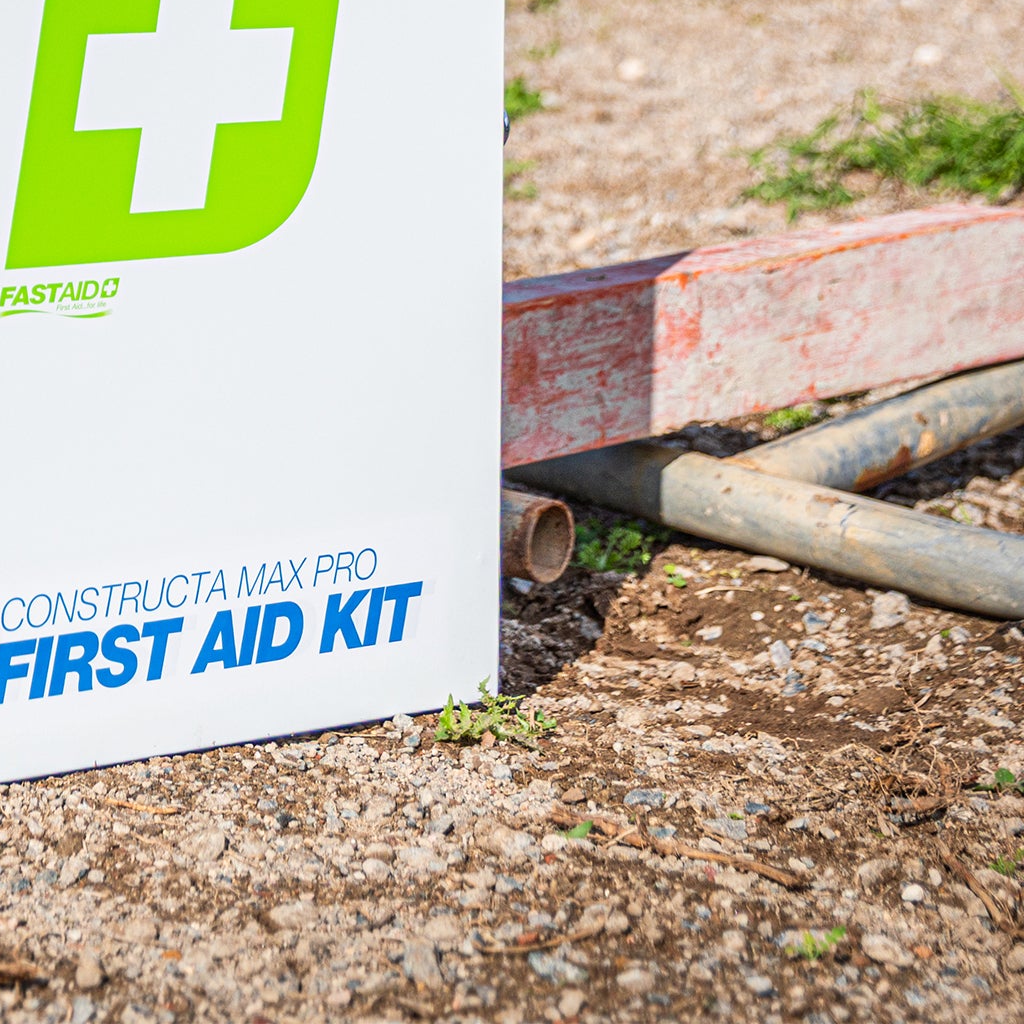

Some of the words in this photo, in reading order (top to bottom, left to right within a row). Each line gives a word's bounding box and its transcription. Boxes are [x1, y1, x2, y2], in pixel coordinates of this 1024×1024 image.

[0, 570, 227, 631] CONSTRUCTA
[237, 557, 307, 598] MAX
[314, 548, 378, 588] PRO
[190, 601, 304, 674] AID
[319, 580, 424, 654] KIT
